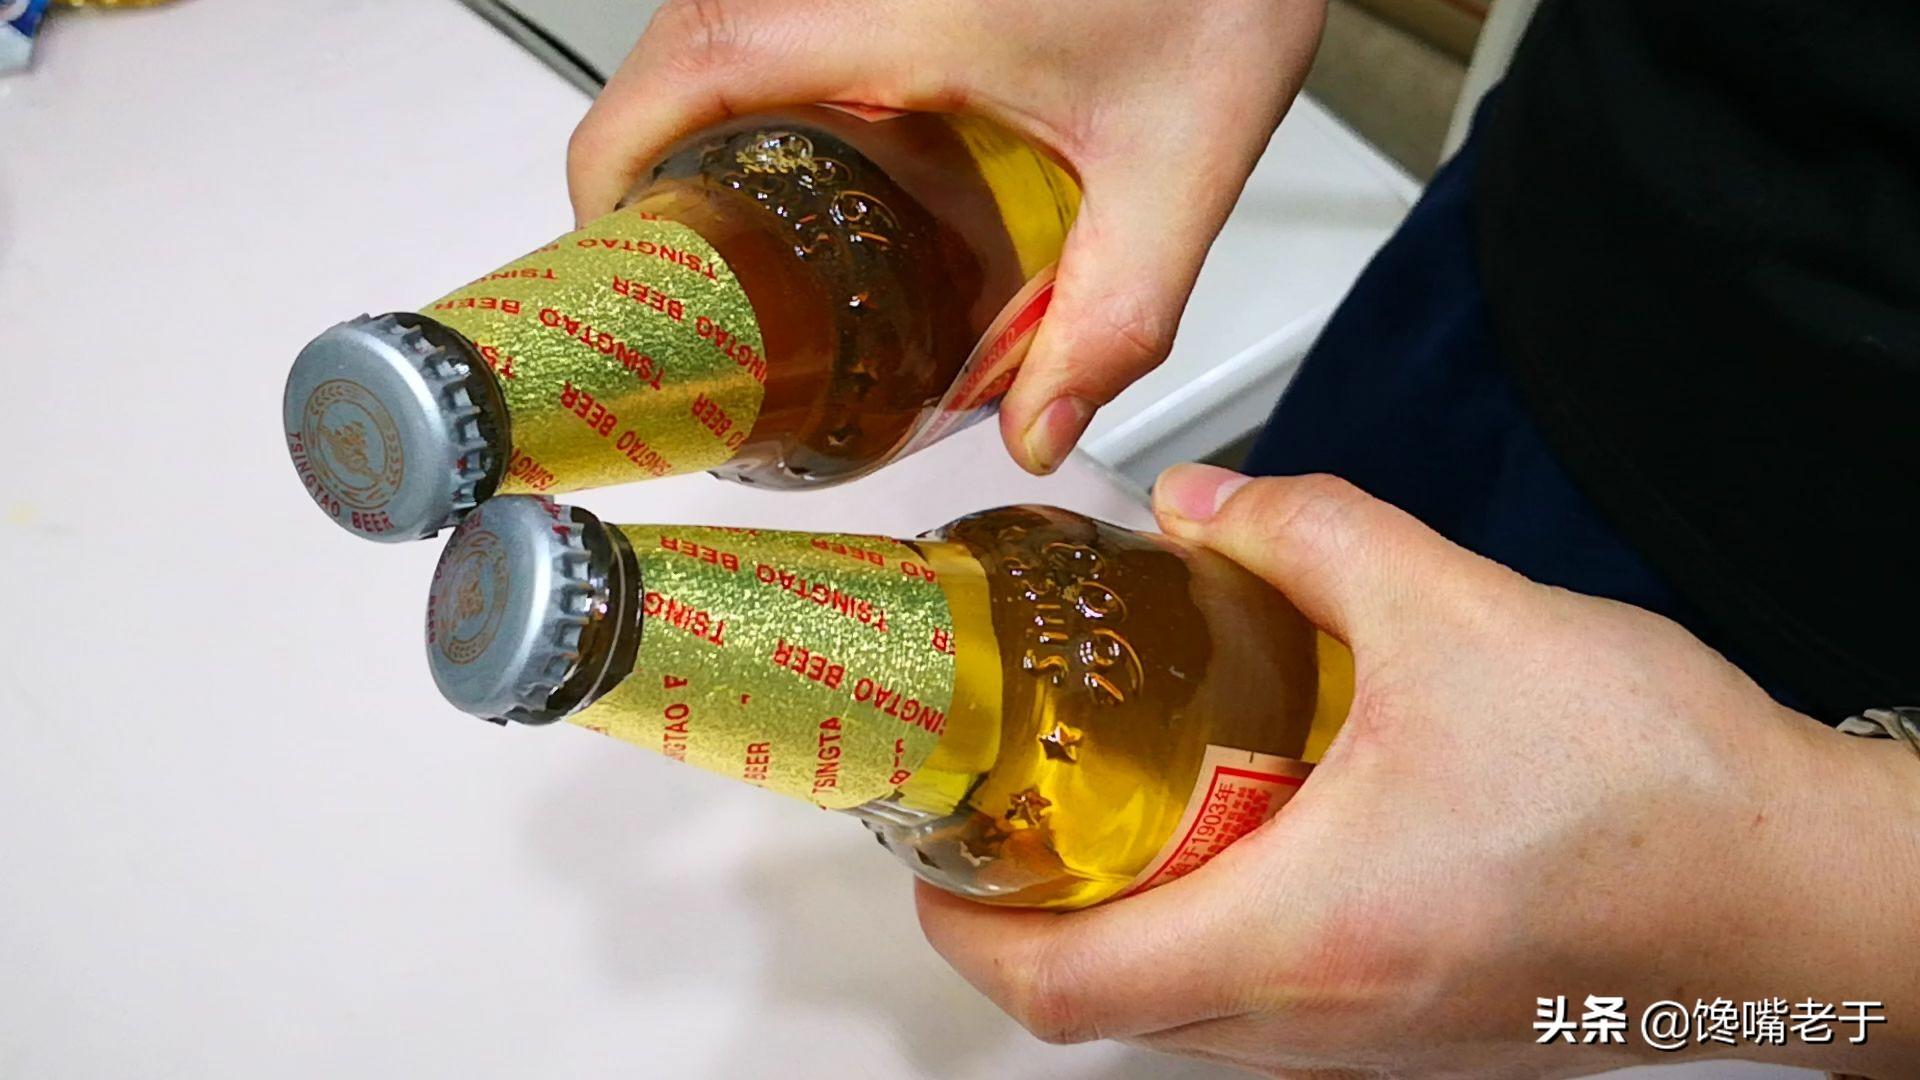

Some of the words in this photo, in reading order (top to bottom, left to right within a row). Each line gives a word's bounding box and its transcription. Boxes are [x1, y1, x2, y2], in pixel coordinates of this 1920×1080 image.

[577, 238, 717, 280] TSINGTAO
[613, 275, 684, 322] BEER
[538, 308, 665, 391] TSINGTAO
[560, 380, 618, 438] BEER
[692, 392, 732, 437] BEER
[289, 430, 341, 518] TSINGTAO
[351, 510, 394, 533] BEER
[659, 535, 739, 572] BEER
[755, 563, 888, 633] TSINGTAO
[773, 638, 846, 690] BEER
